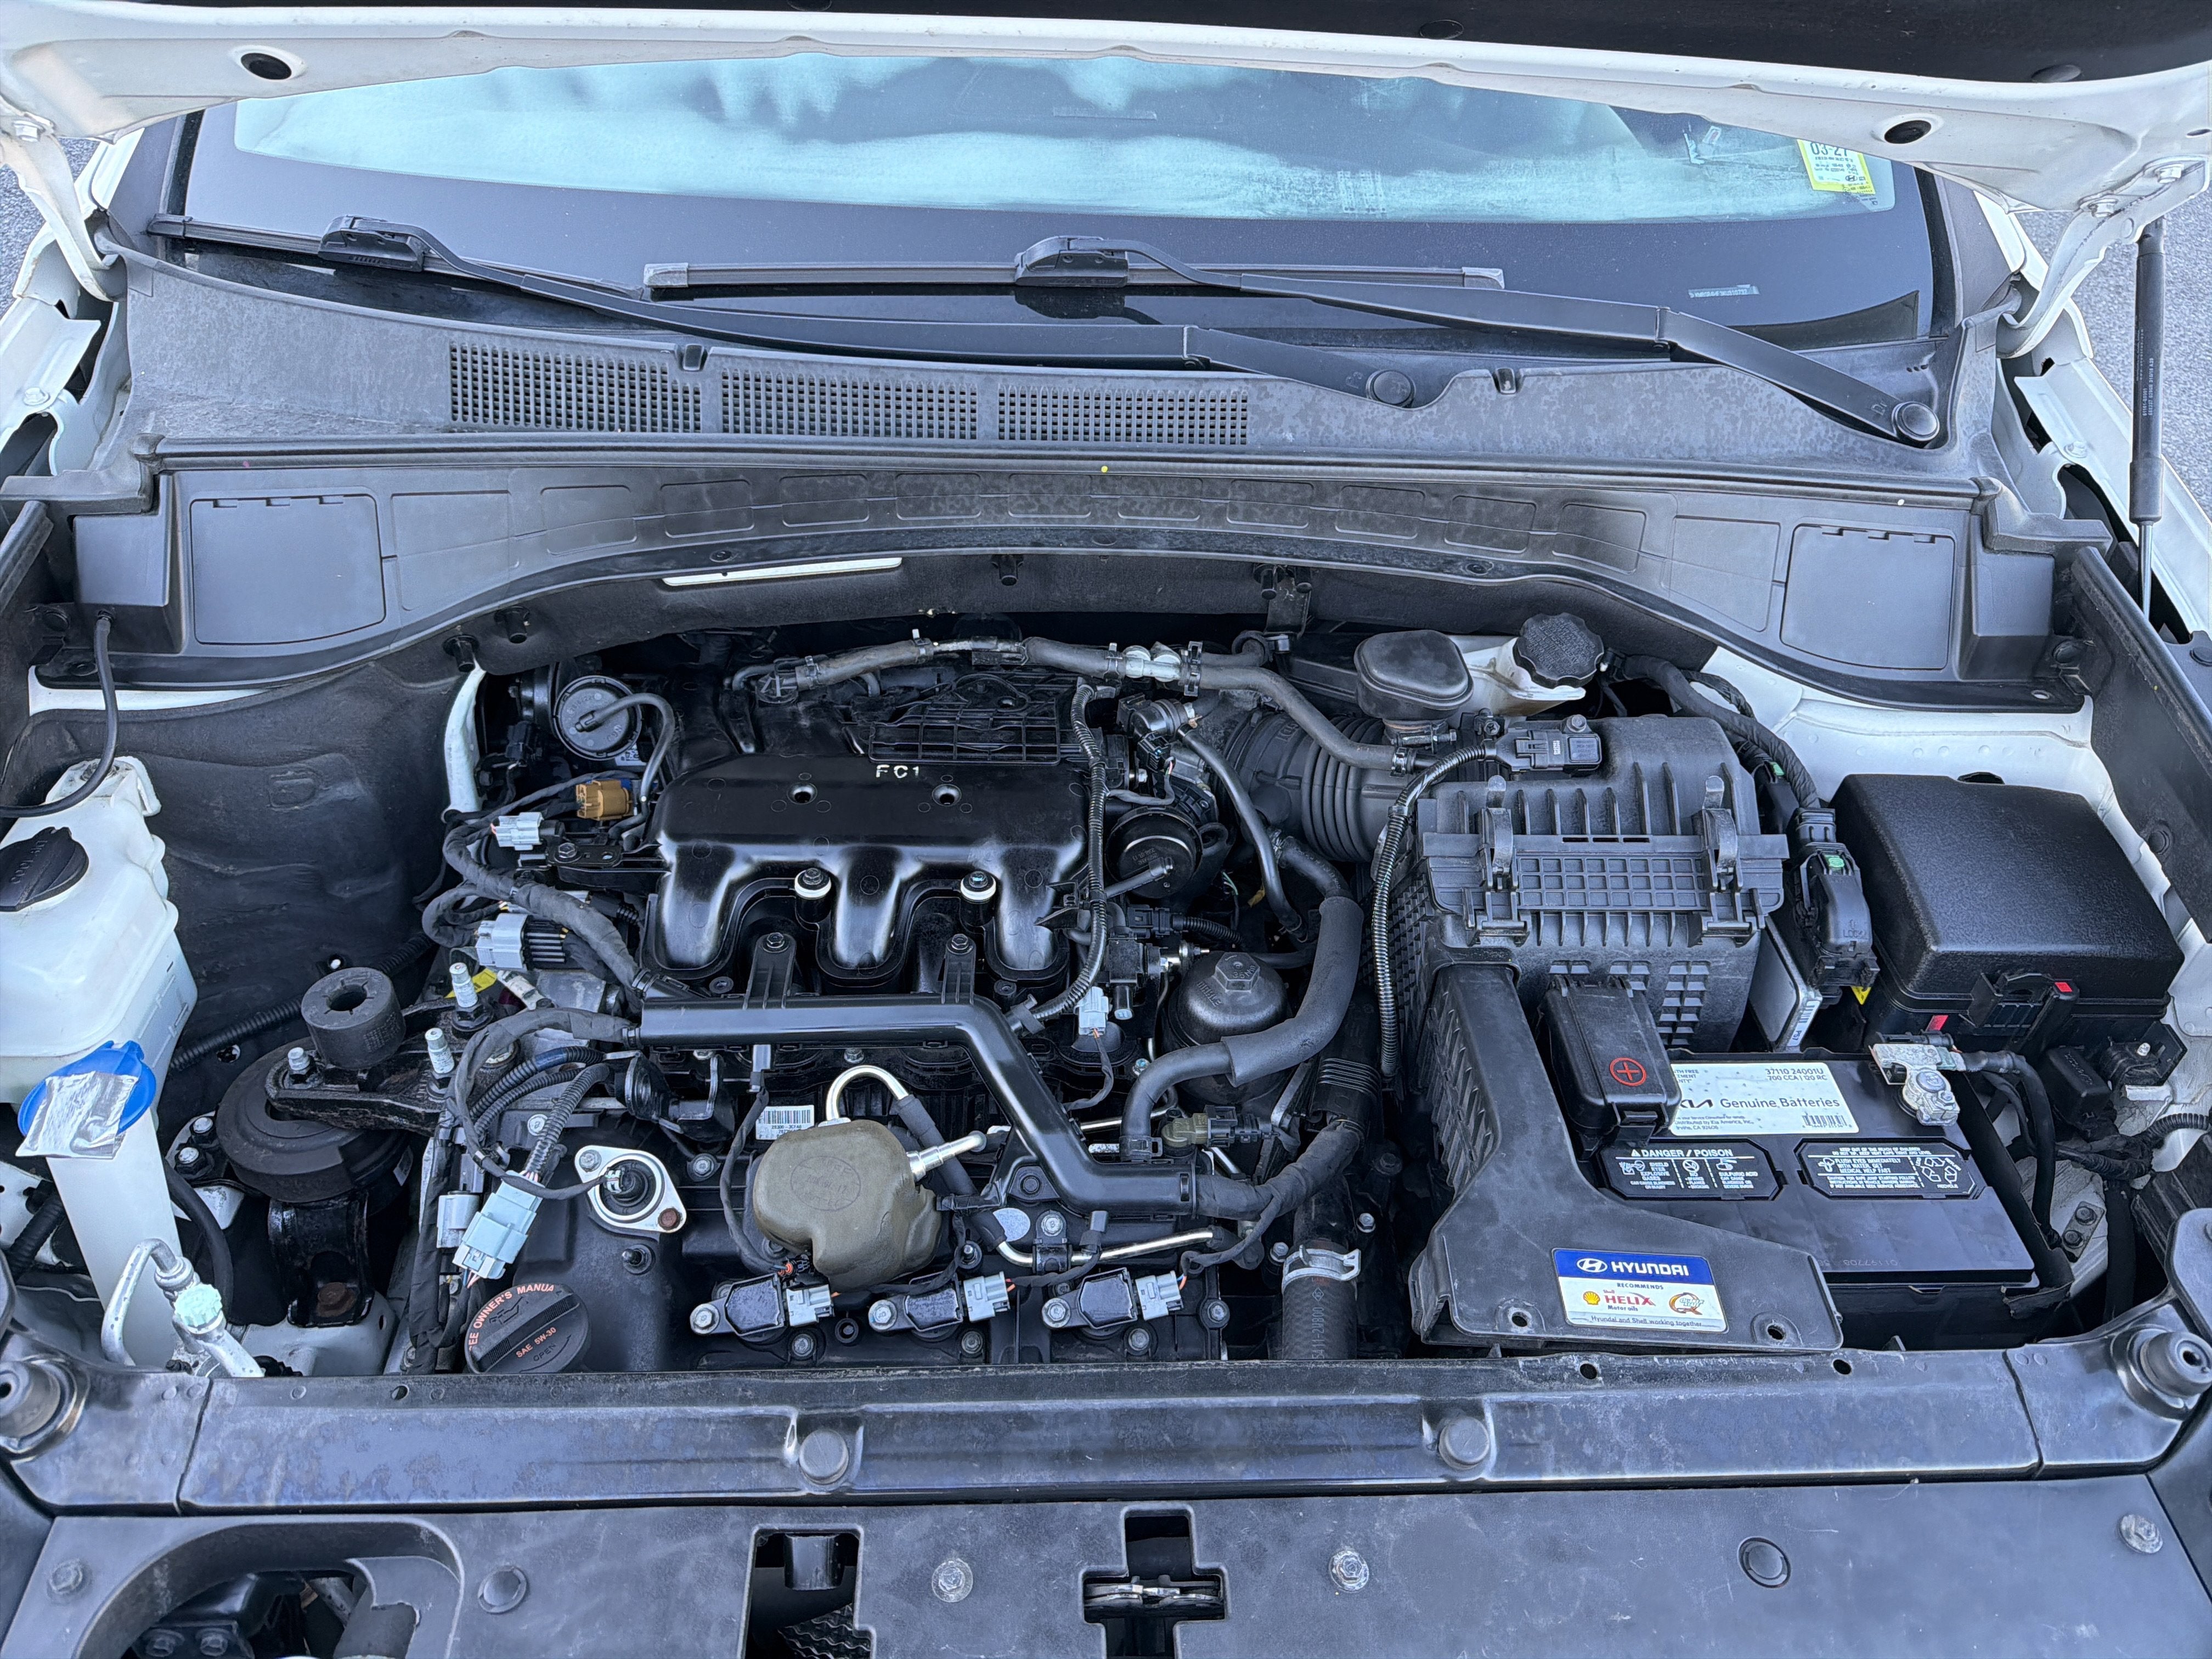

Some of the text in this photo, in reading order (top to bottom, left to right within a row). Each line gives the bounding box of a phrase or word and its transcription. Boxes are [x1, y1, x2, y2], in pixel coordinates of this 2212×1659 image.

[876, 764, 919, 778] FC1
[1720, 1098, 1776, 1108] Genuine
[1779, 1098, 1840, 1107] Batteries
[1694, 1149, 1734, 1157] POISON
[1611, 1261, 1690, 1277] HYUNDAI
[1617, 1282, 1664, 1290] RECOMMENDS
[473, 1291, 513, 1329] OWNER'S
[517, 1283, 555, 1295] MANUA
[1604, 1294, 1655, 1306] HELIX
[516, 1327, 557, 1358] SAE 5W-30
[533, 1344, 556, 1362] OPEN
